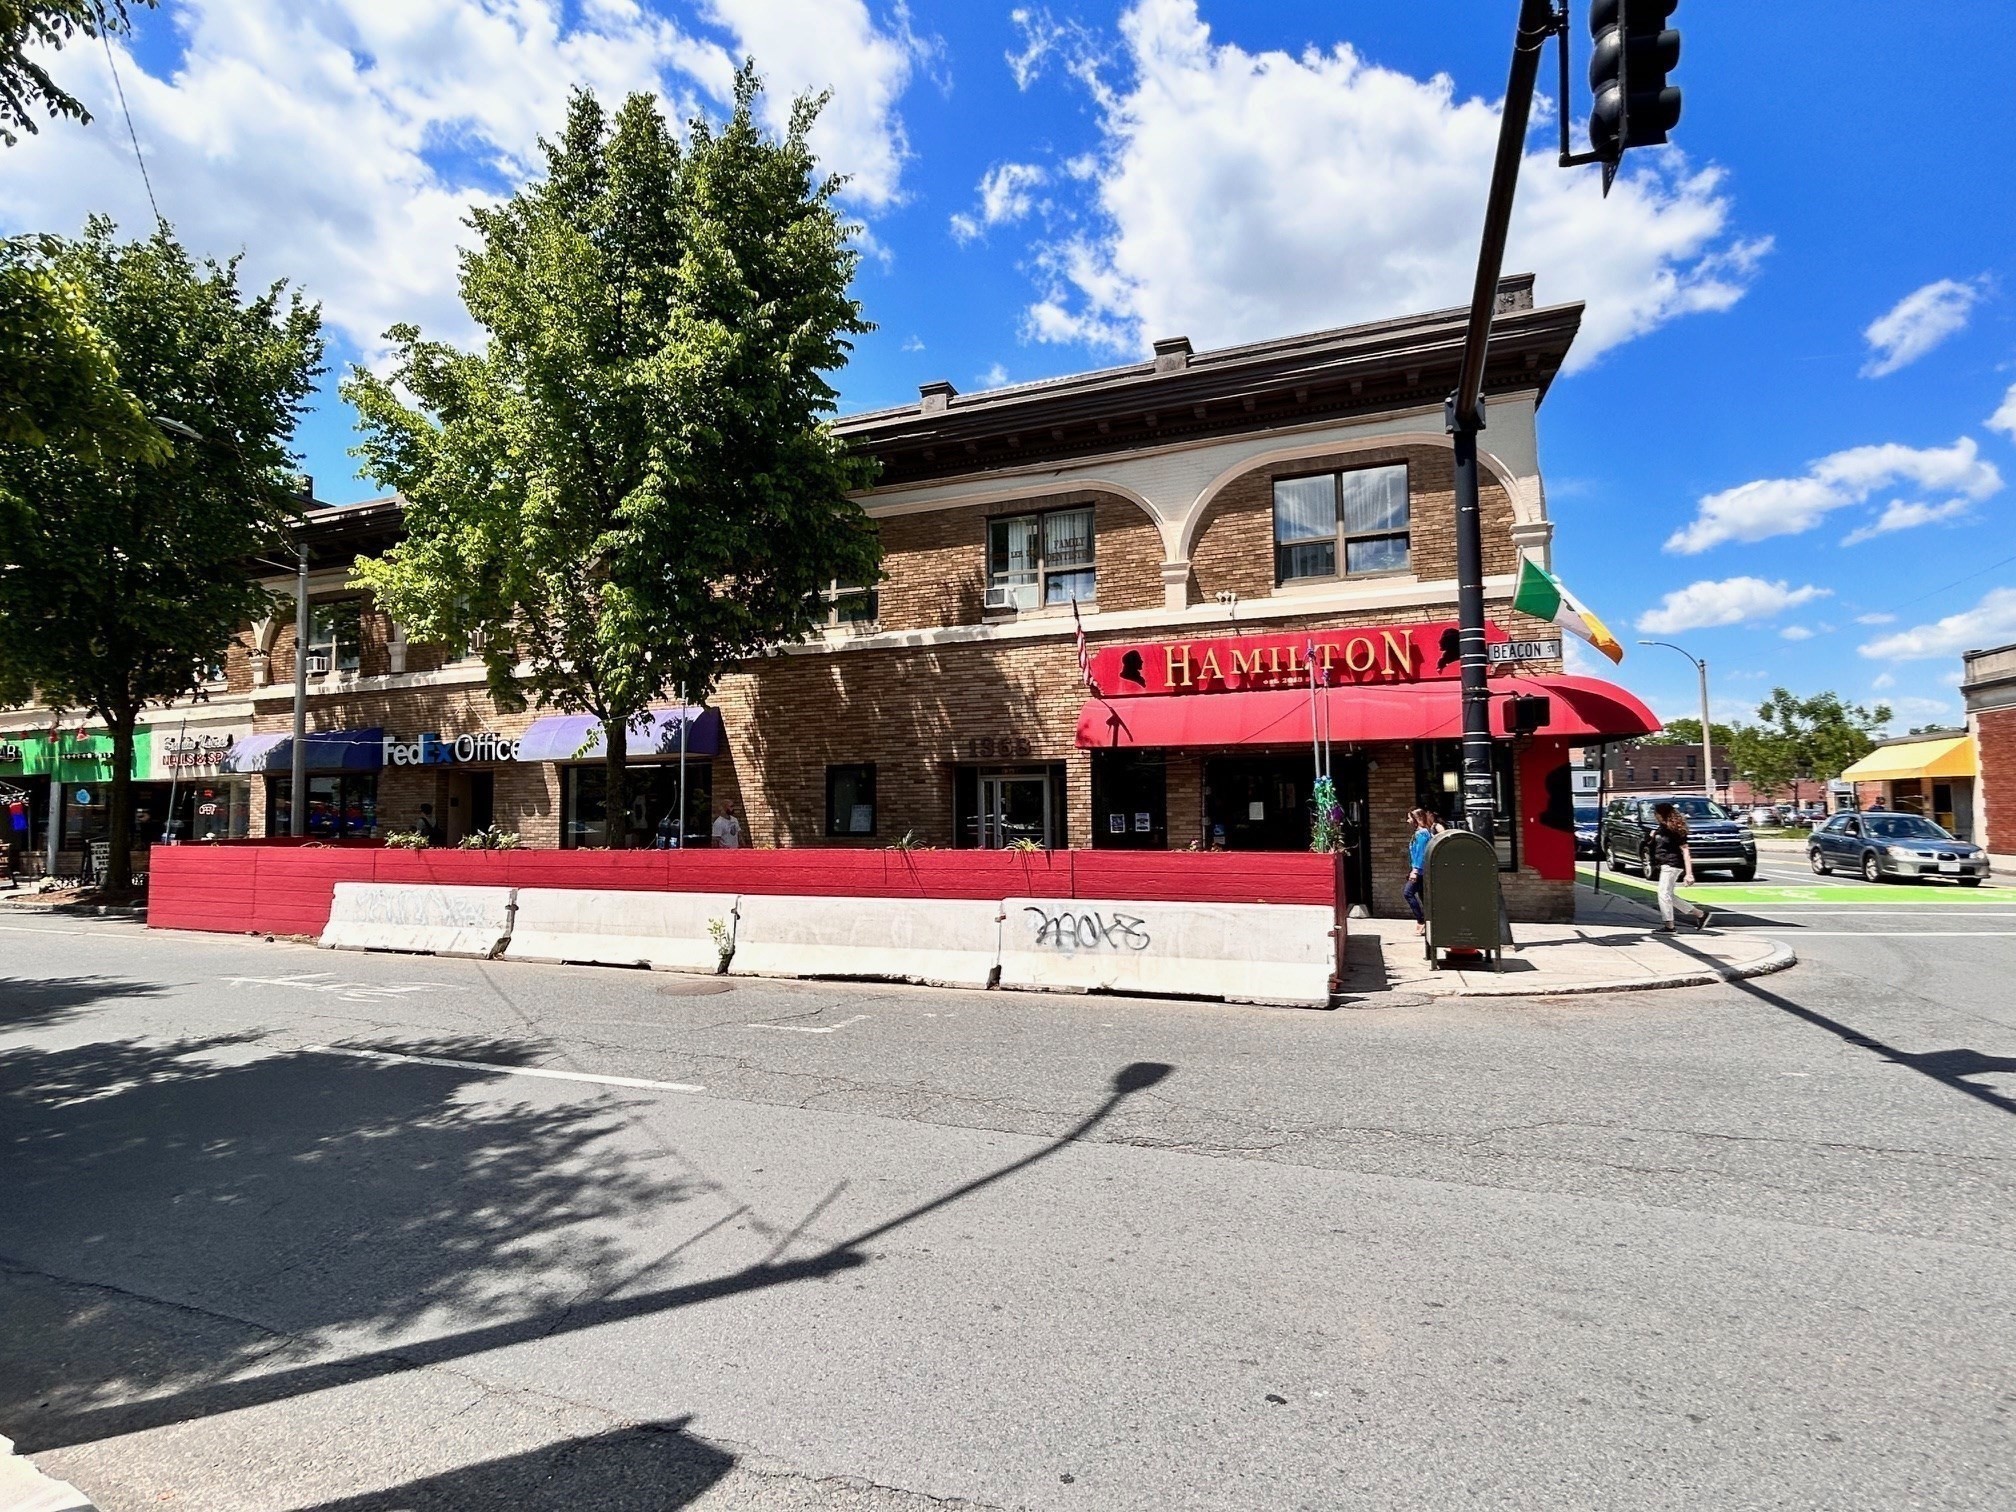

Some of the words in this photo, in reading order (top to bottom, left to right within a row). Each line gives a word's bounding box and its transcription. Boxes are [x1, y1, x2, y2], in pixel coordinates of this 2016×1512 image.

[1162, 629, 1415, 688] HAMILTON
[1493, 643, 1541, 659] BEACON
[1547, 644, 1555, 653] ST
[382, 732, 453, 766] FedEx
[454, 732, 521, 763] Office
[162, 753, 196, 768] NAILS
[196, 752, 208, 766] &
[208, 750, 229, 765] SP
[199, 803, 216, 815] OPEN
